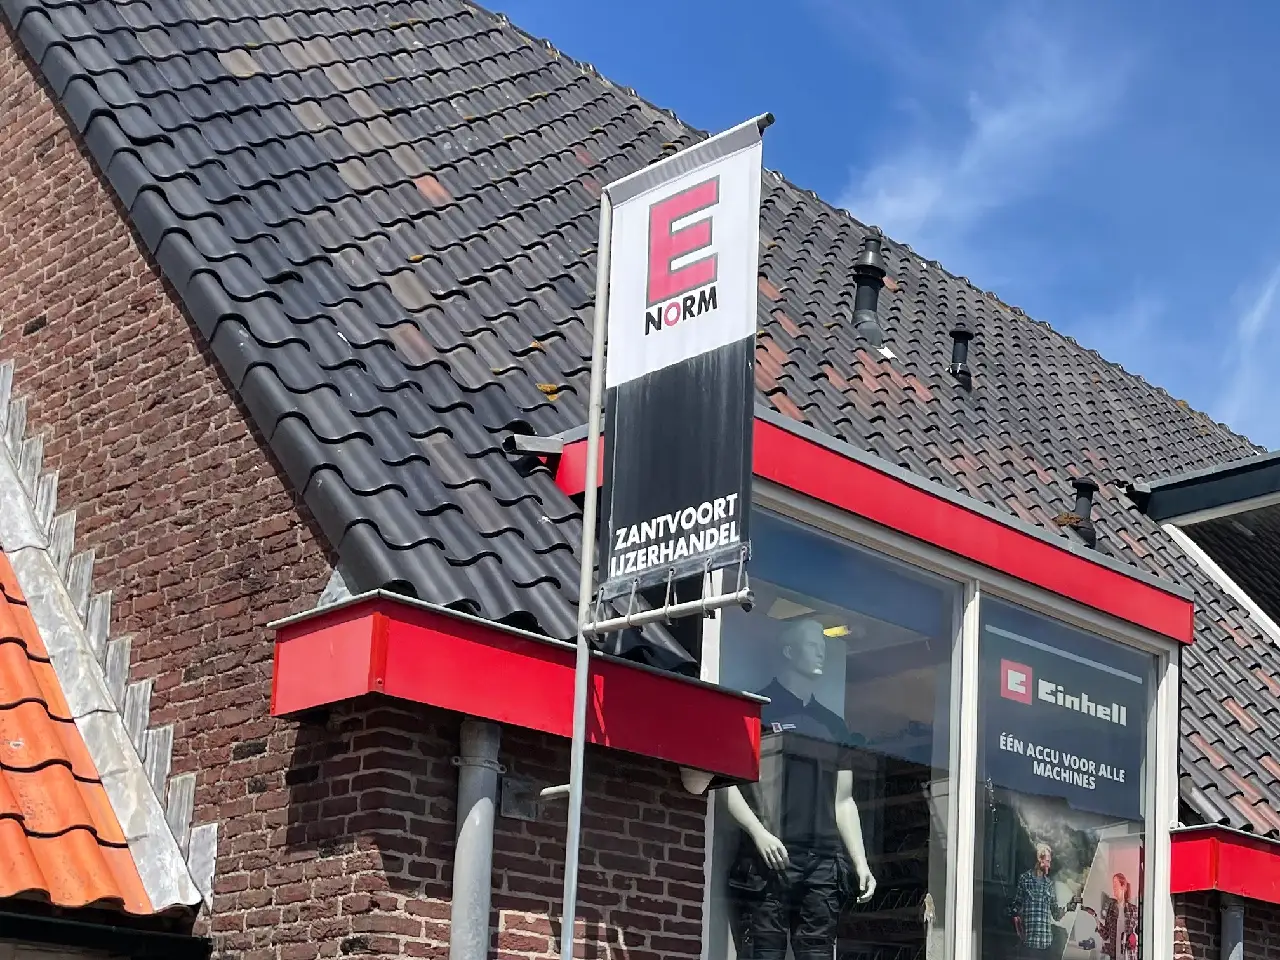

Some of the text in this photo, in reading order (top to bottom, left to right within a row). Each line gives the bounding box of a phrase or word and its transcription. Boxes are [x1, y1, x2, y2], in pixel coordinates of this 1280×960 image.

[645, 174, 720, 304] E
[644, 296, 719, 336] NORM
[614, 493, 738, 551] ZANTVOORT
[609, 521, 740, 578] IJZERHANDEL
[1038, 678, 1127, 727] Einhell
[1000, 731, 1126, 783] ÉÉN ACCU VOOR ALLE
[1033, 760, 1096, 790] MACHINES
